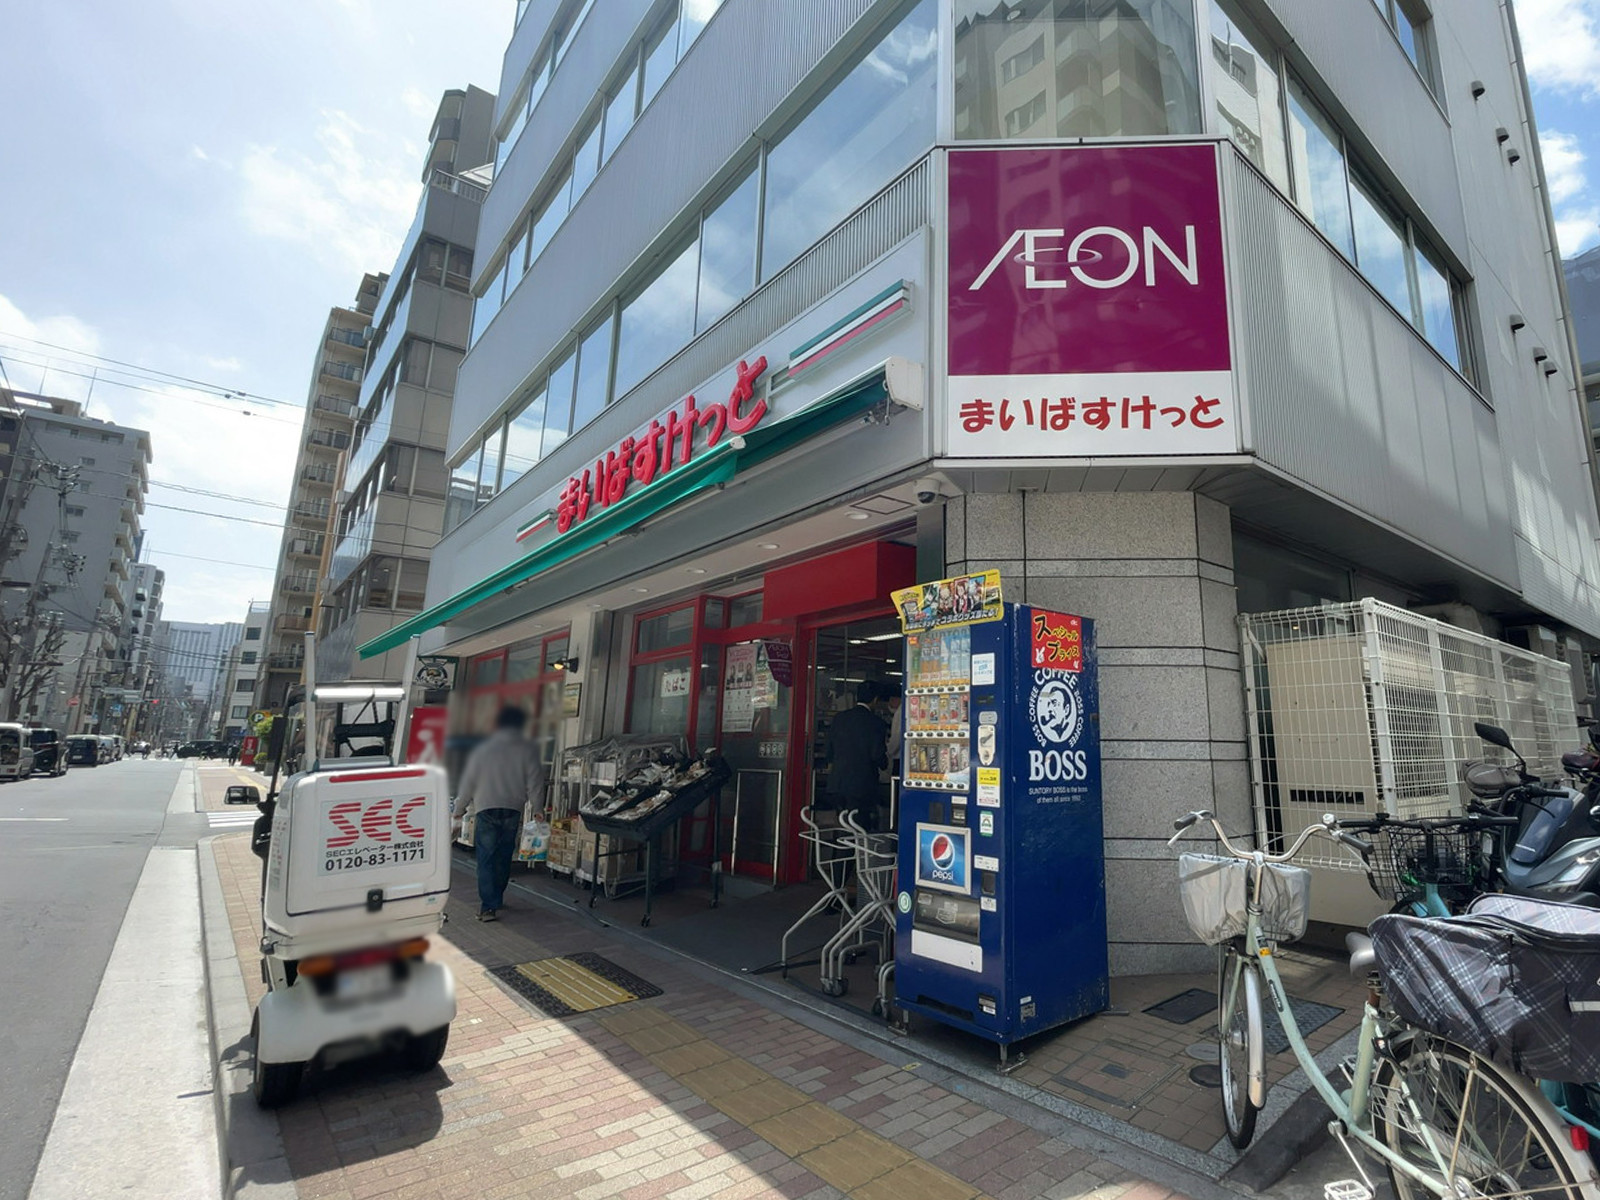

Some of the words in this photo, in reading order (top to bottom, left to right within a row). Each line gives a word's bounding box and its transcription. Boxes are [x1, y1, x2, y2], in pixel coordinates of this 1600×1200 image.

[968, 225, 1199, 290] AEON
[959, 395, 1225, 433] まいばすけっと
[556, 355, 768, 535] まいばすけっと
[1034, 614, 1079, 641] スペシャル
[1046, 640, 1080, 662] プライス
[1028, 686, 1039, 722] COFFEE
[1073, 689, 1084, 714] BOSS
[1032, 724, 1047, 748] BOSS
[1069, 716, 1084, 748] COFFEE
[1028, 749, 1087, 781] BOSS
[326, 796, 426, 848] SEC
[325, 849, 424, 871] 0120-83-1171
[326, 841, 424, 858] SECエレベーター株式会社
[932, 870, 953, 880] pepsi
